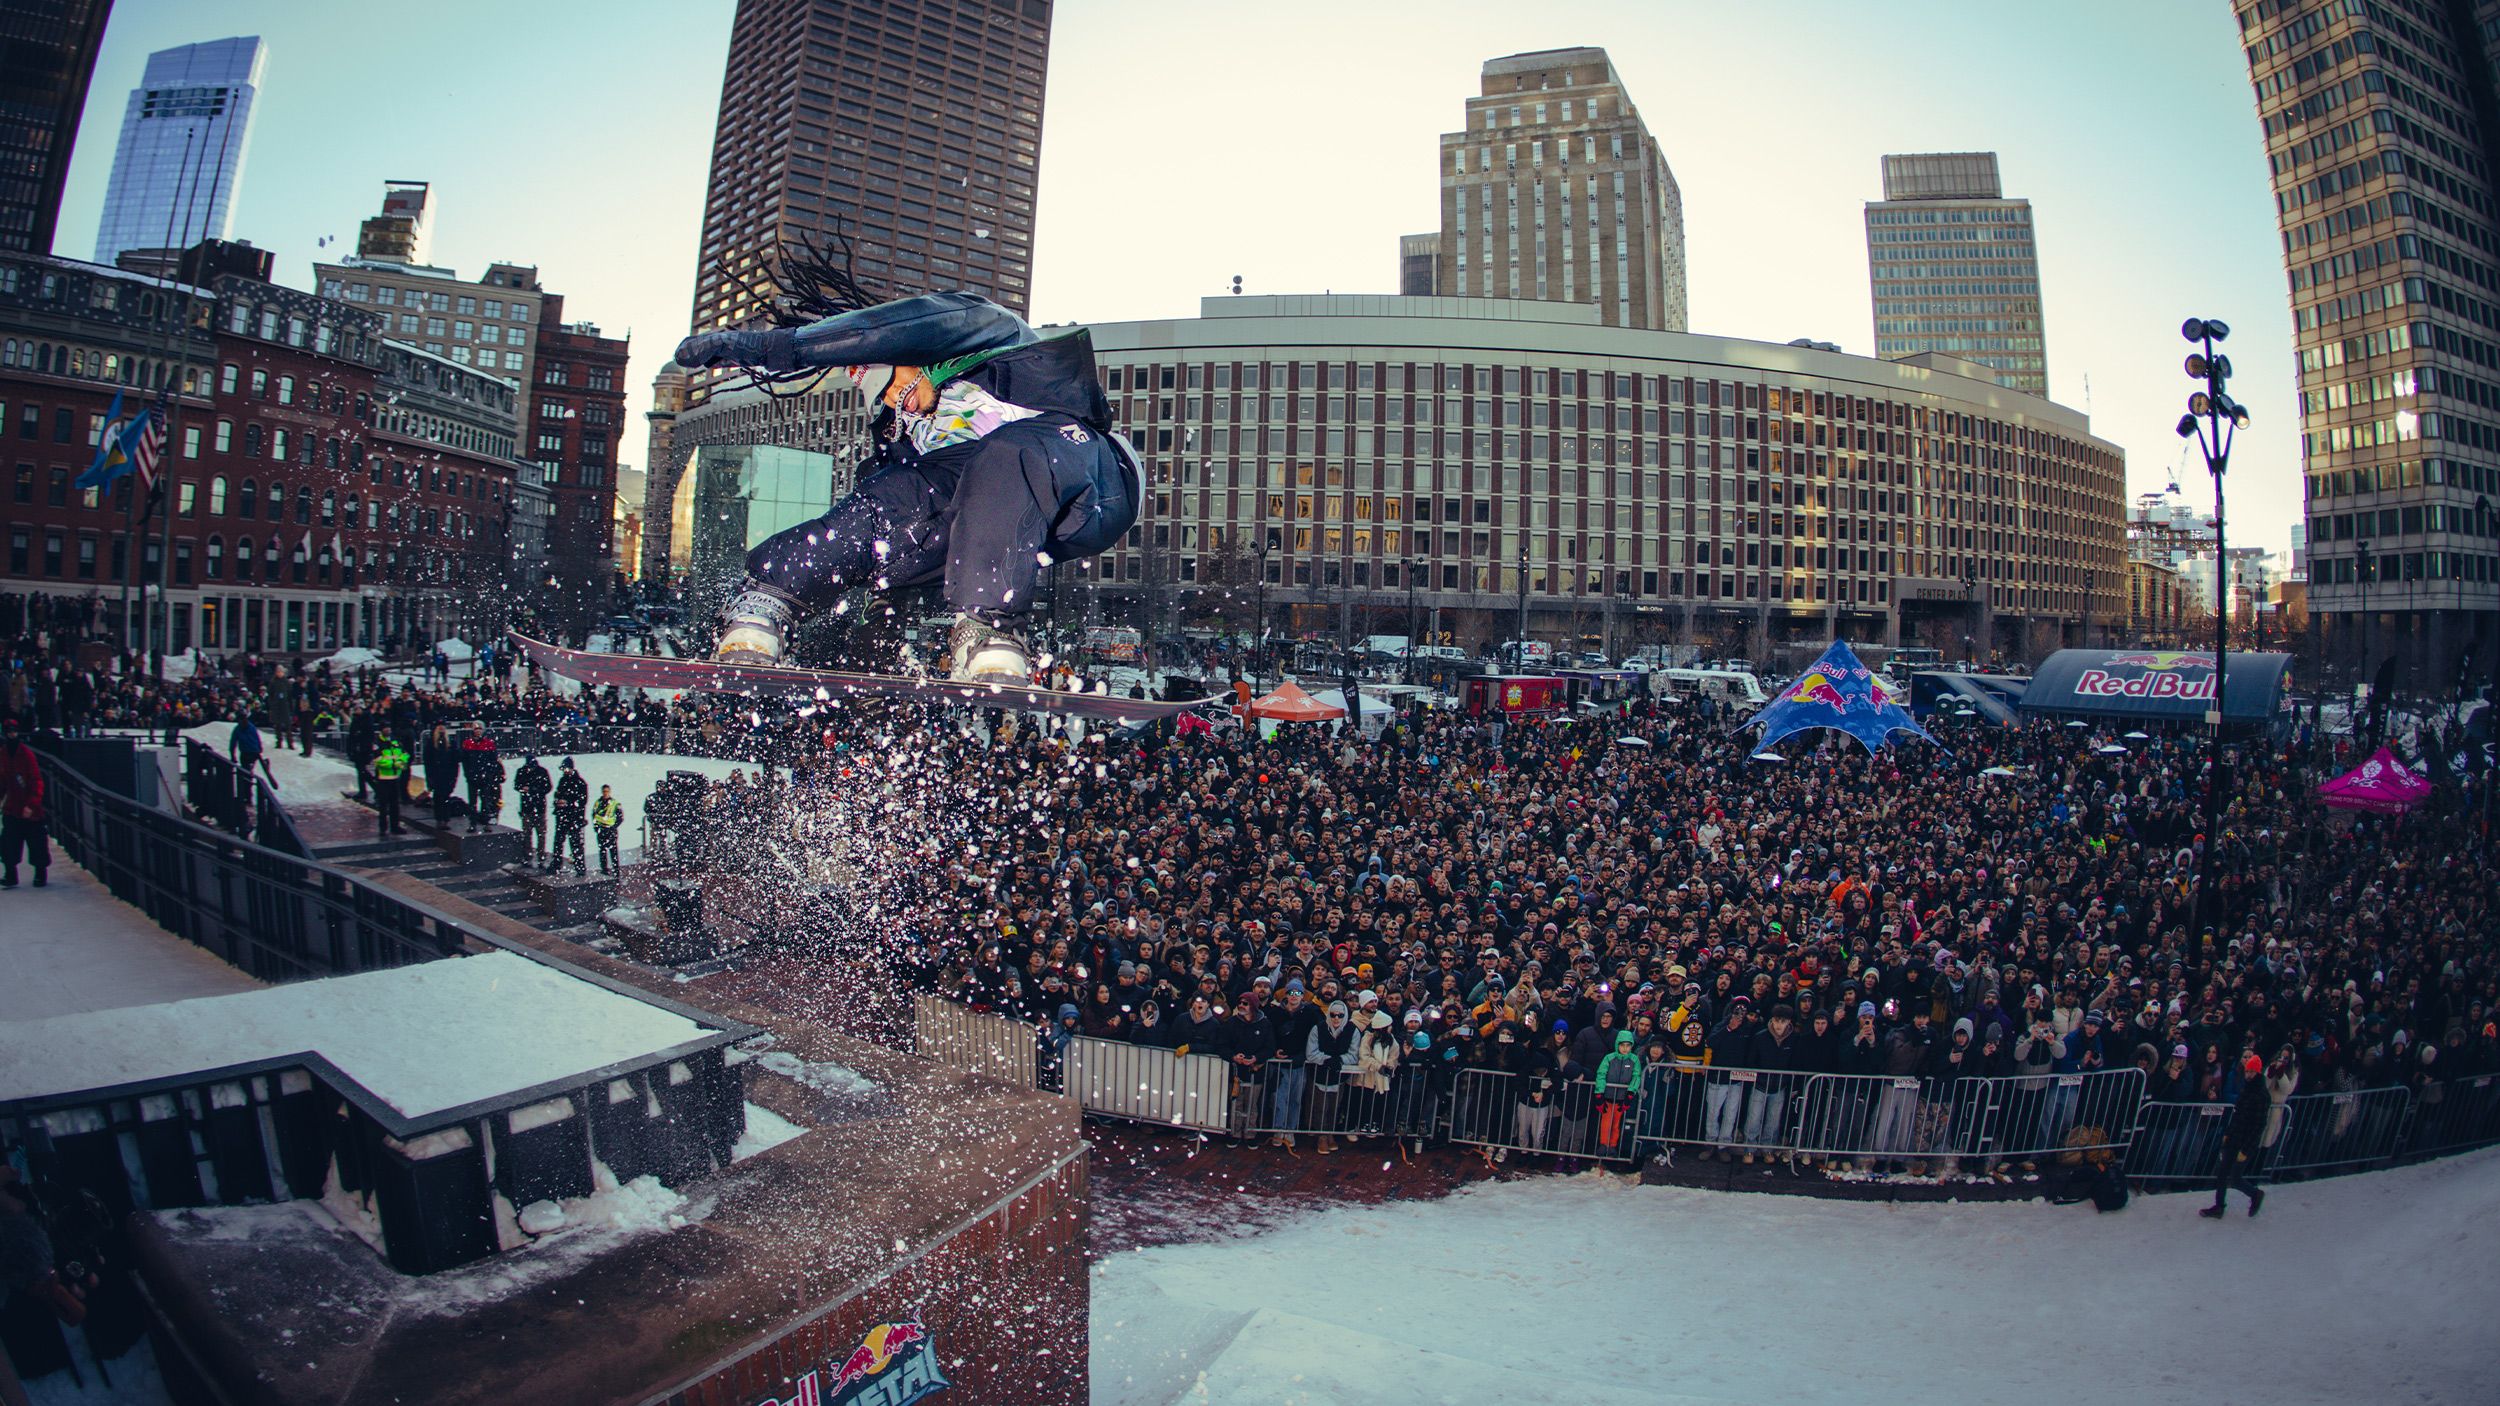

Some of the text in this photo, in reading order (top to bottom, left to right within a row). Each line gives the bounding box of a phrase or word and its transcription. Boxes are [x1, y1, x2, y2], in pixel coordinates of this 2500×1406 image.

[1917, 588, 1946, 601] CENTER
[1820, 661, 1848, 681] Bull
[2074, 670, 2156, 698] Red
[846, 1330, 953, 1406] ETAL
